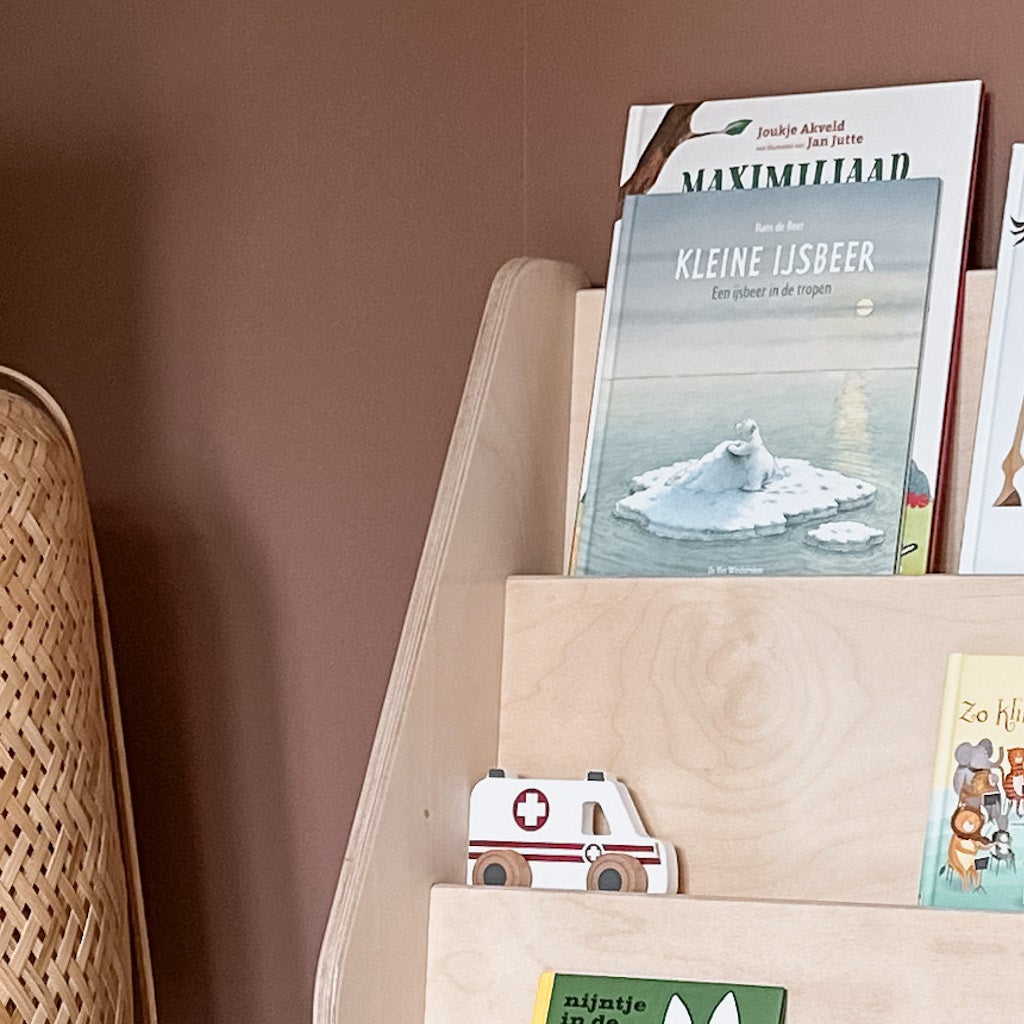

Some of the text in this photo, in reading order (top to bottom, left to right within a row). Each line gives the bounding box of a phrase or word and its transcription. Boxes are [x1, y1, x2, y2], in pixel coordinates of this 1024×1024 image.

[756, 119, 845, 140] Joukje Akveld
[806, 136, 828, 150] Jan
[830, 134, 864, 148] Jutte
[675, 240, 875, 281] KLEINE IJSBEER
[712, 283, 832, 301] Een ijsbeer in de tropen
[959, 700, 988, 723] Zo
[563, 993, 647, 1016] nijntje
